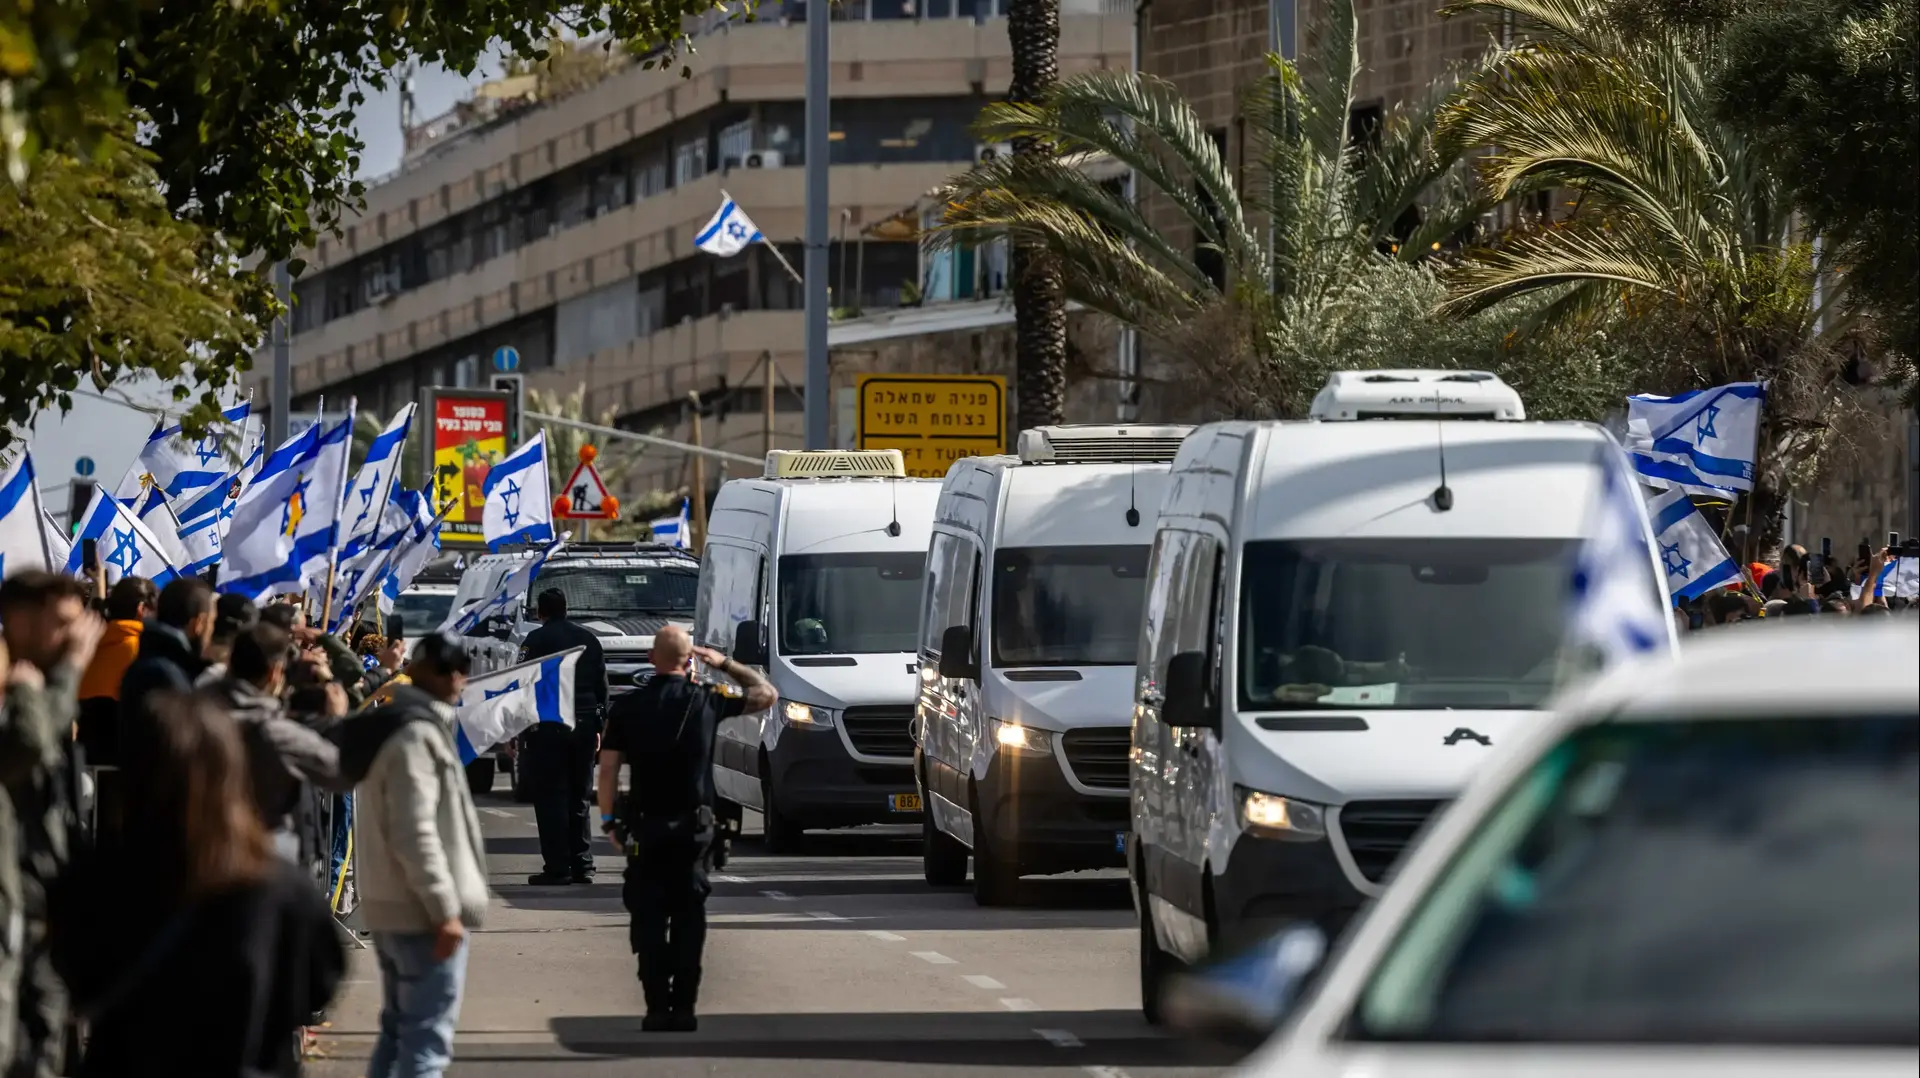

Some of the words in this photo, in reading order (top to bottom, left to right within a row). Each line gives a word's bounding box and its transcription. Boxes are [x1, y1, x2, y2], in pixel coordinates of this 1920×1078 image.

[874, 391, 936, 404] שמאלה
[949, 393, 988, 406] פניה
[876, 413, 918, 425] השני
[931, 413, 985, 425] בצומת
[904, 449, 923, 460] FT
